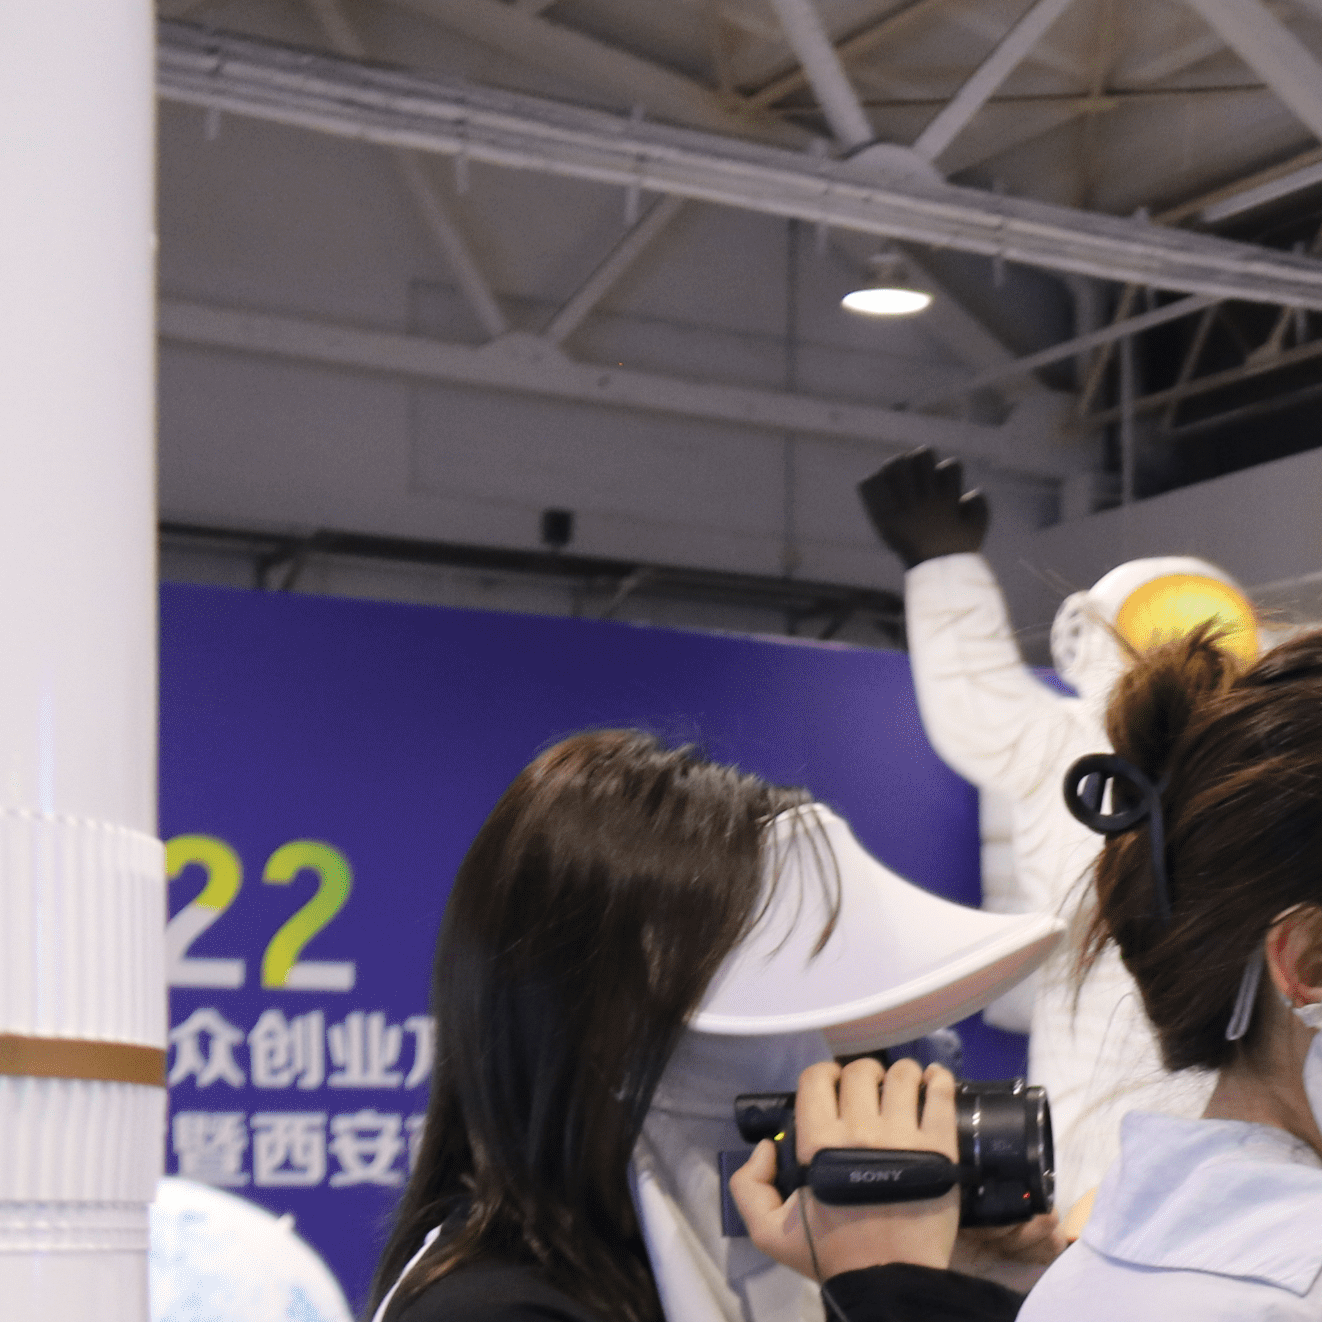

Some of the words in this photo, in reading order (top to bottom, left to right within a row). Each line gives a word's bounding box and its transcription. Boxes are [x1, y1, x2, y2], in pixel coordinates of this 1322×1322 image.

[165, 834, 356, 992] 22
[172, 1110, 430, 1188] 暨西安
[849, 1169, 903, 1183] SONY
